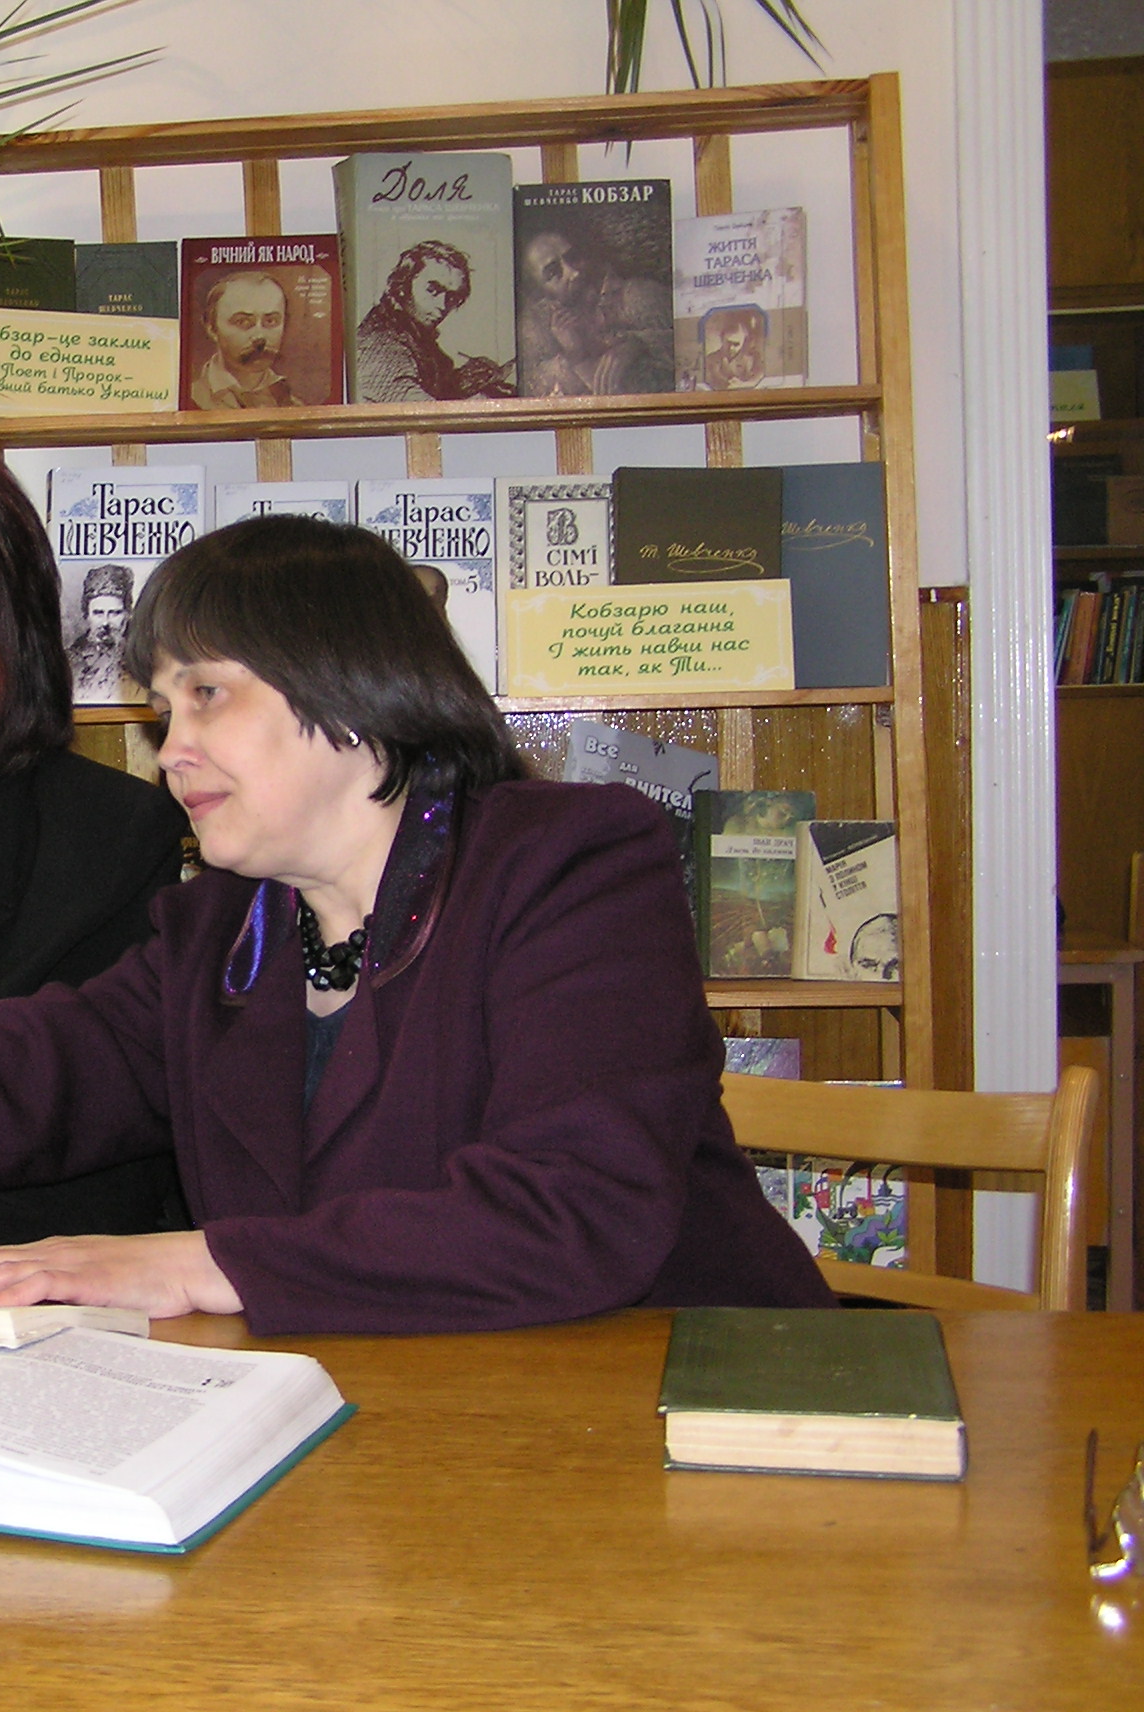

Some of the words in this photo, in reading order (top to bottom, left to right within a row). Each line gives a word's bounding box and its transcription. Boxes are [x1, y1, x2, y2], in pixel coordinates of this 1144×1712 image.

[372, 160, 473, 203] Доля
[523, 196, 579, 206] ШЕВЧЕНКО
[549, 188, 578, 197] ТАРАС
[582, 185, 654, 204] КОБЗАР
[211, 241, 256, 264] ВІЧНИЙ
[257, 246, 274, 263] ЯК
[276, 245, 315, 264] НАРОД
[708, 237, 757, 254] ЖИТТЯ
[704, 253, 761, 269] ТАРАСА
[694, 269, 773, 287] ШЕВЧЕНКА
[108, 294, 133, 302] ТАРАС
[98, 304, 143, 313] ШЕВЧЕНКО
[88, 335, 151, 350] заклик
[9, 344, 32, 362] до
[39, 346, 116, 367] єднання
[37, 380, 95, 396] батько
[99, 384, 170, 401] України)
[92, 482, 175, 522] Тарас
[395, 493, 471, 530] Тарас
[546, 508, 579, 546] В
[59, 519, 195, 556] ШЕВЧЕНКО
[466, 575, 478, 594] 5
[534, 570, 600, 588] ВОЛЬ-
[570, 602, 669, 624] Кобзарю
[680, 602, 734, 617] наш,
[562, 622, 623, 641] почуй
[632, 620, 734, 636] благання
[572, 643, 632, 658] жить
[640, 637, 702, 656] навчи
[711, 638, 750, 652] нас
[578, 662, 629, 677] так,
[637, 662, 662, 674] як
[584, 735, 619, 760] Все
[619, 761, 639, 774] для
